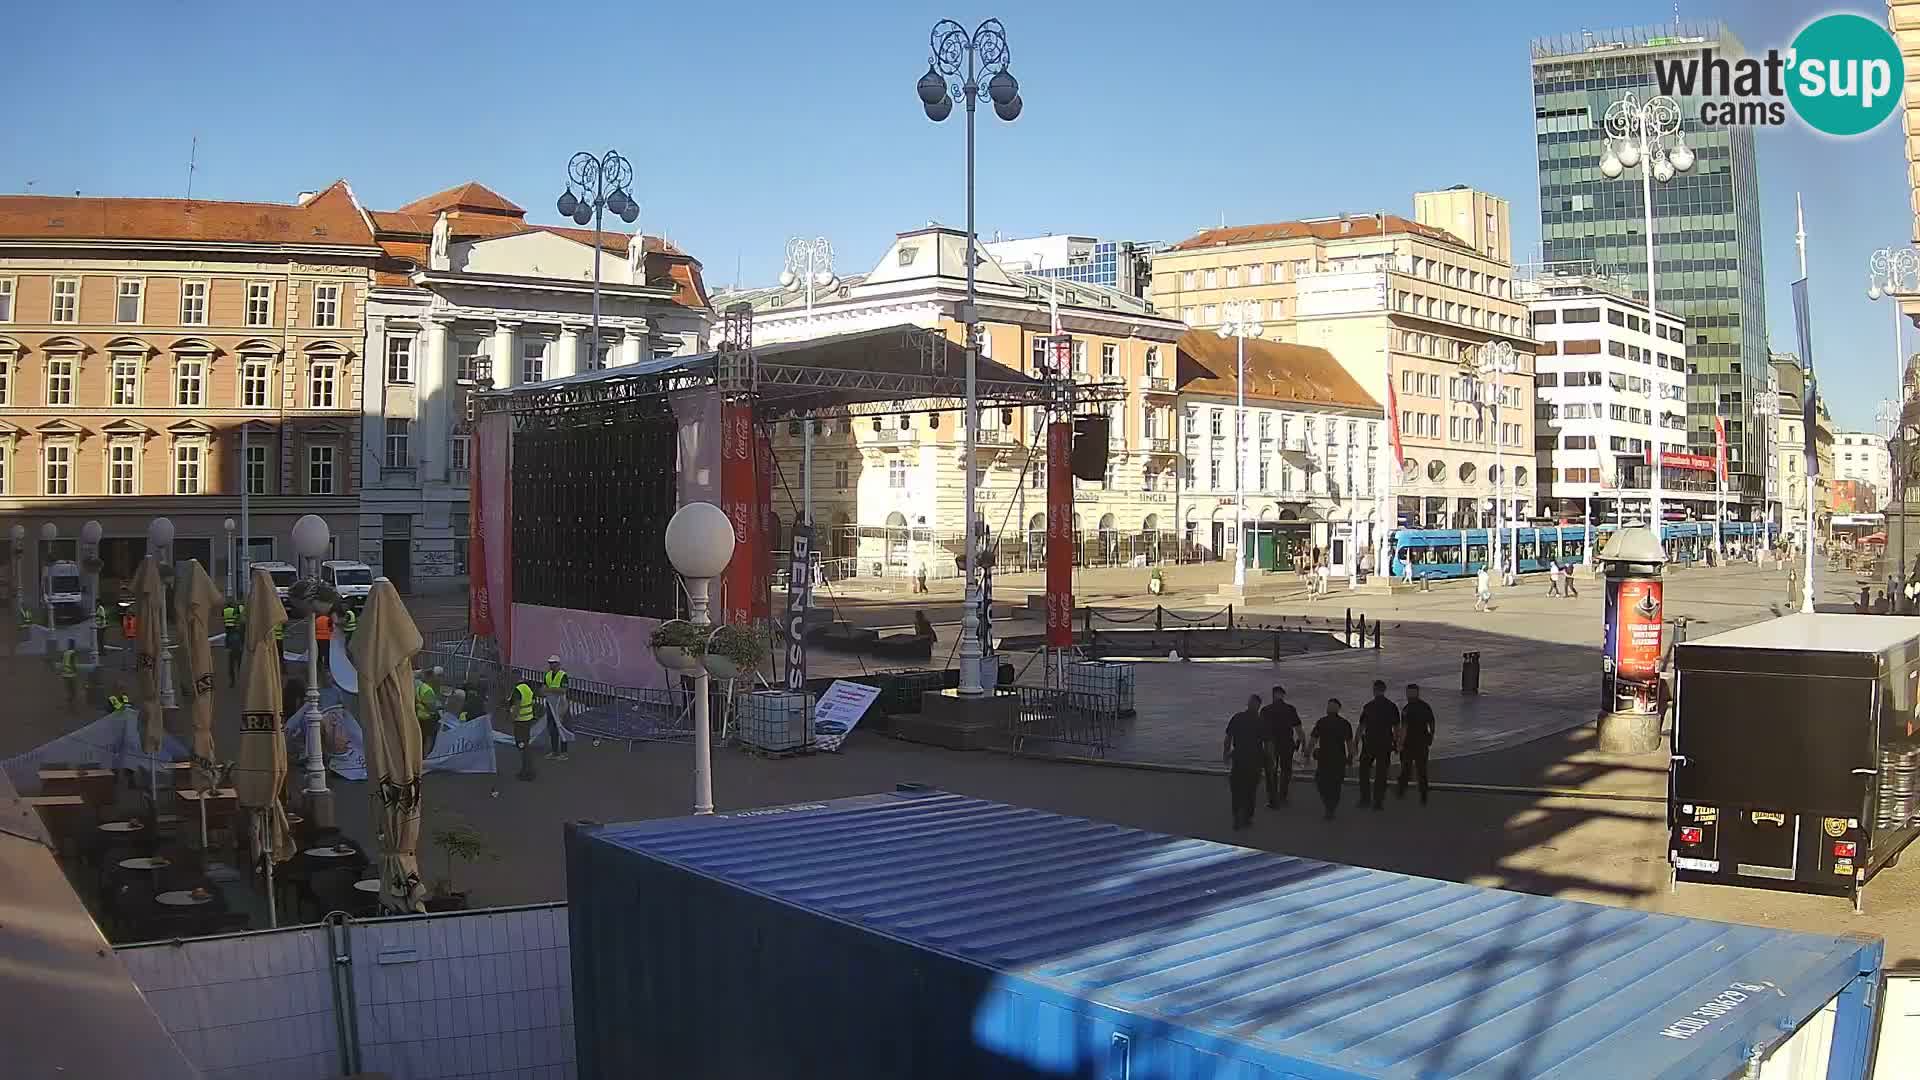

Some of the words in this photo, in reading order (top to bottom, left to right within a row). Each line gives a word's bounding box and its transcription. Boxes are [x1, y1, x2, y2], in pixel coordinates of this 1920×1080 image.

[735, 416, 749, 460] Coca-Cola
[735, 501, 748, 544] Coca-Cola
[1660, 1016, 1710, 1040] MCDU
[1692, 989, 1748, 1019] 300629
